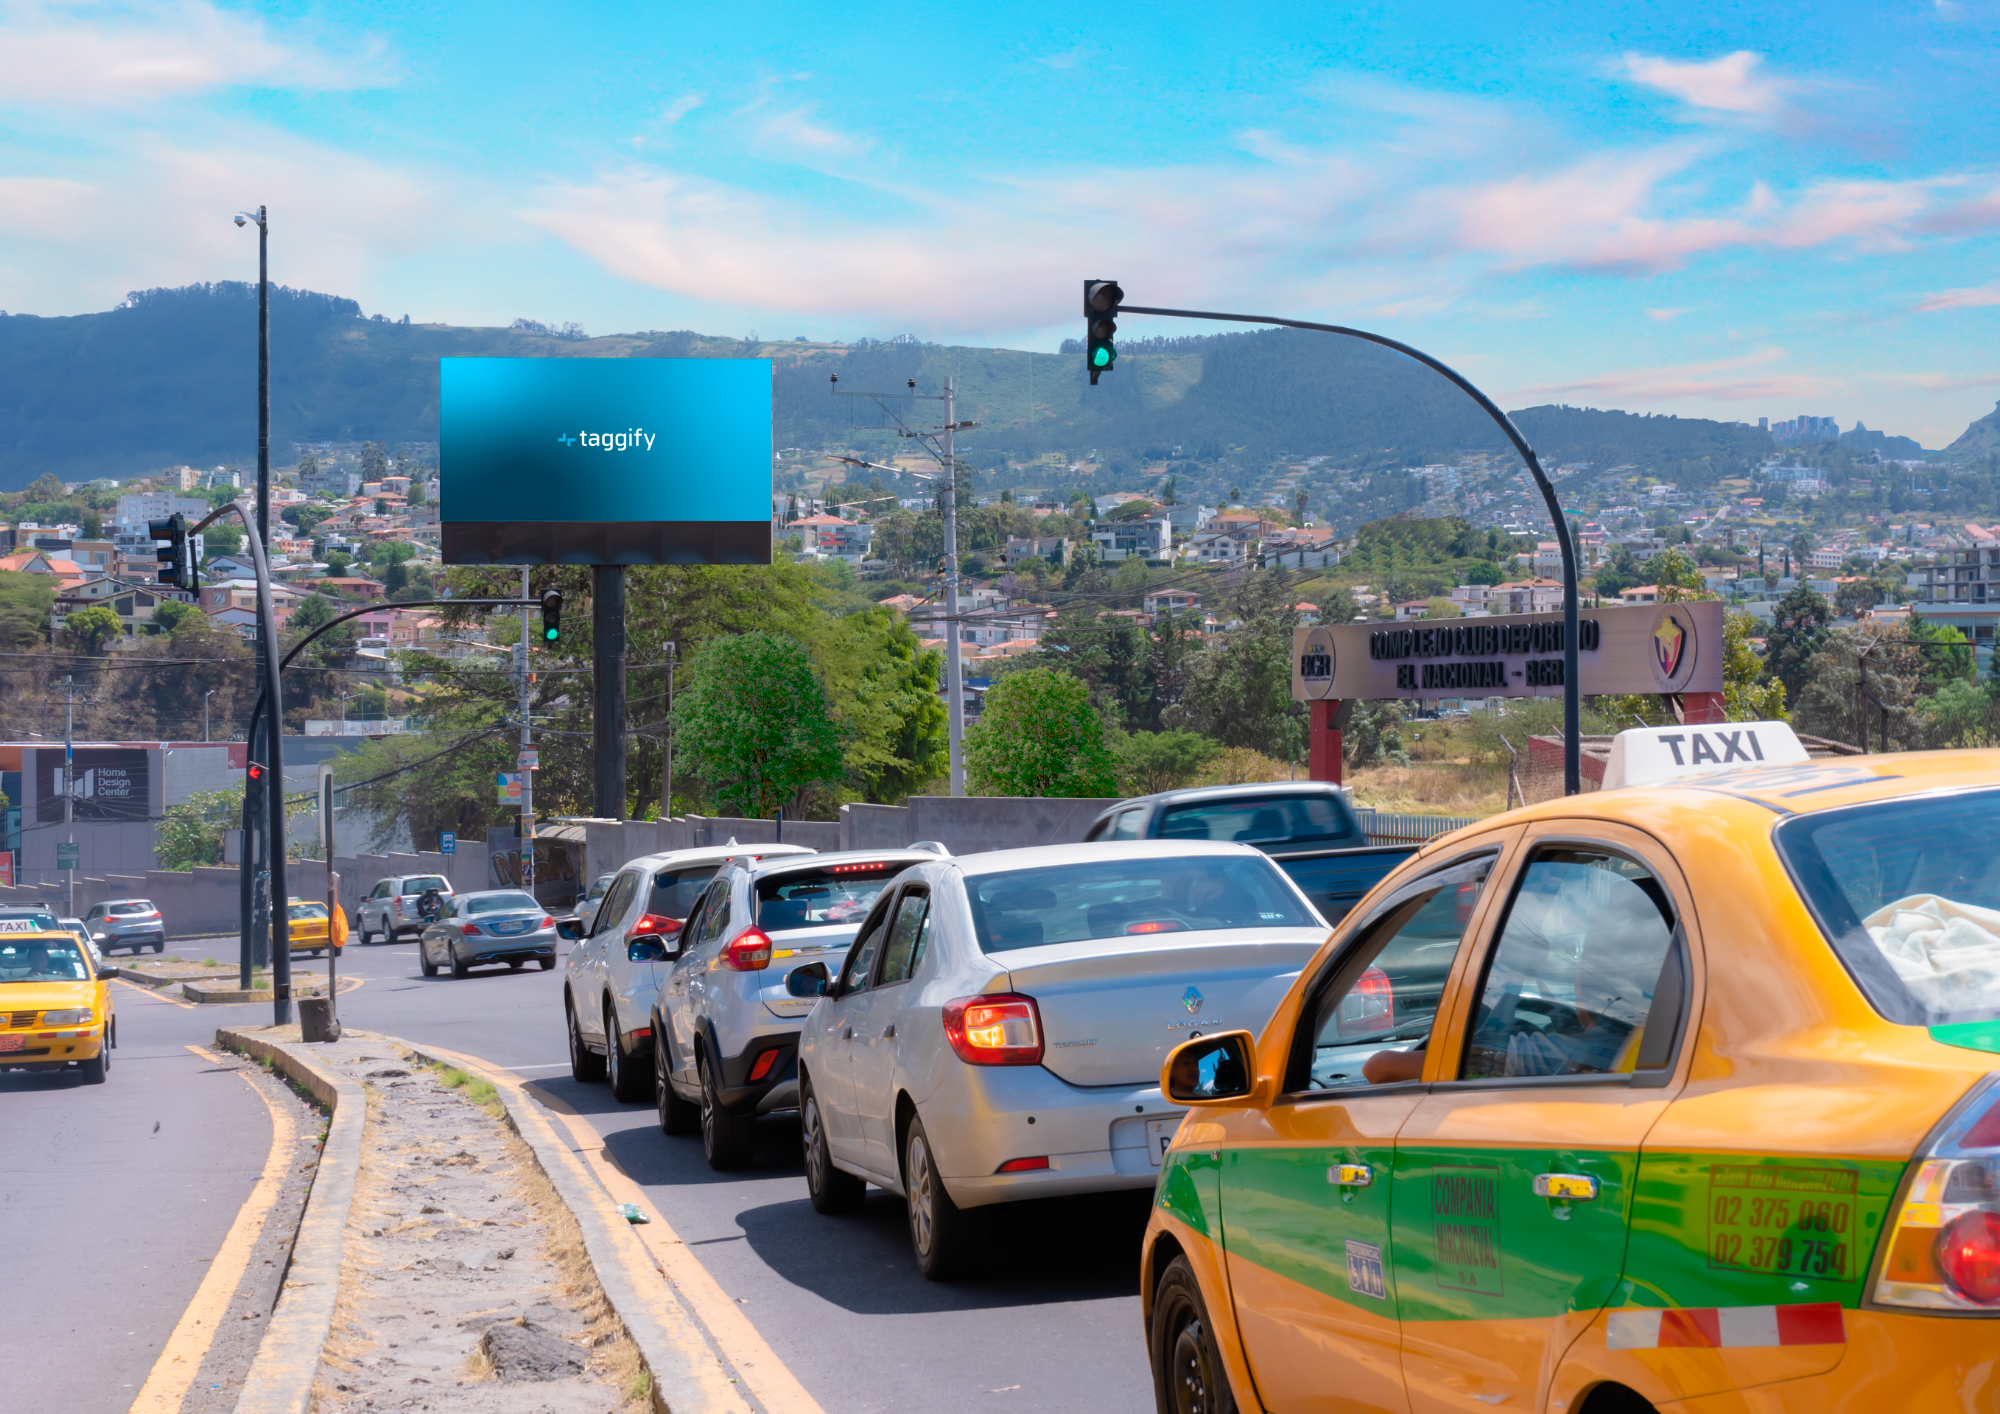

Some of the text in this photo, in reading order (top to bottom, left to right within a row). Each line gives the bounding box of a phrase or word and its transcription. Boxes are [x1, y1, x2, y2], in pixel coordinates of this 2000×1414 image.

[579, 427, 656, 451] taggify
[1369, 618, 1600, 660] COMPLEJO CLUB DEPORTO
[1301, 654, 1331, 677] BGR
[1396, 664, 1419, 690] EL
[1421, 661, 1508, 689] NACIONAL
[1657, 730, 1765, 766] TAXI
[98, 767, 127, 777] Home
[98, 777, 131, 789] Design
[98, 787, 131, 797] Center
[0, 921, 27, 931] TAXI
[1166, 1018, 1223, 1031] LOGAN
[1435, 1176, 1495, 1219] COMPANIA
[1714, 1195, 1850, 1234] 02 375 060
[1714, 1233, 1848, 1276] 02 379 754
